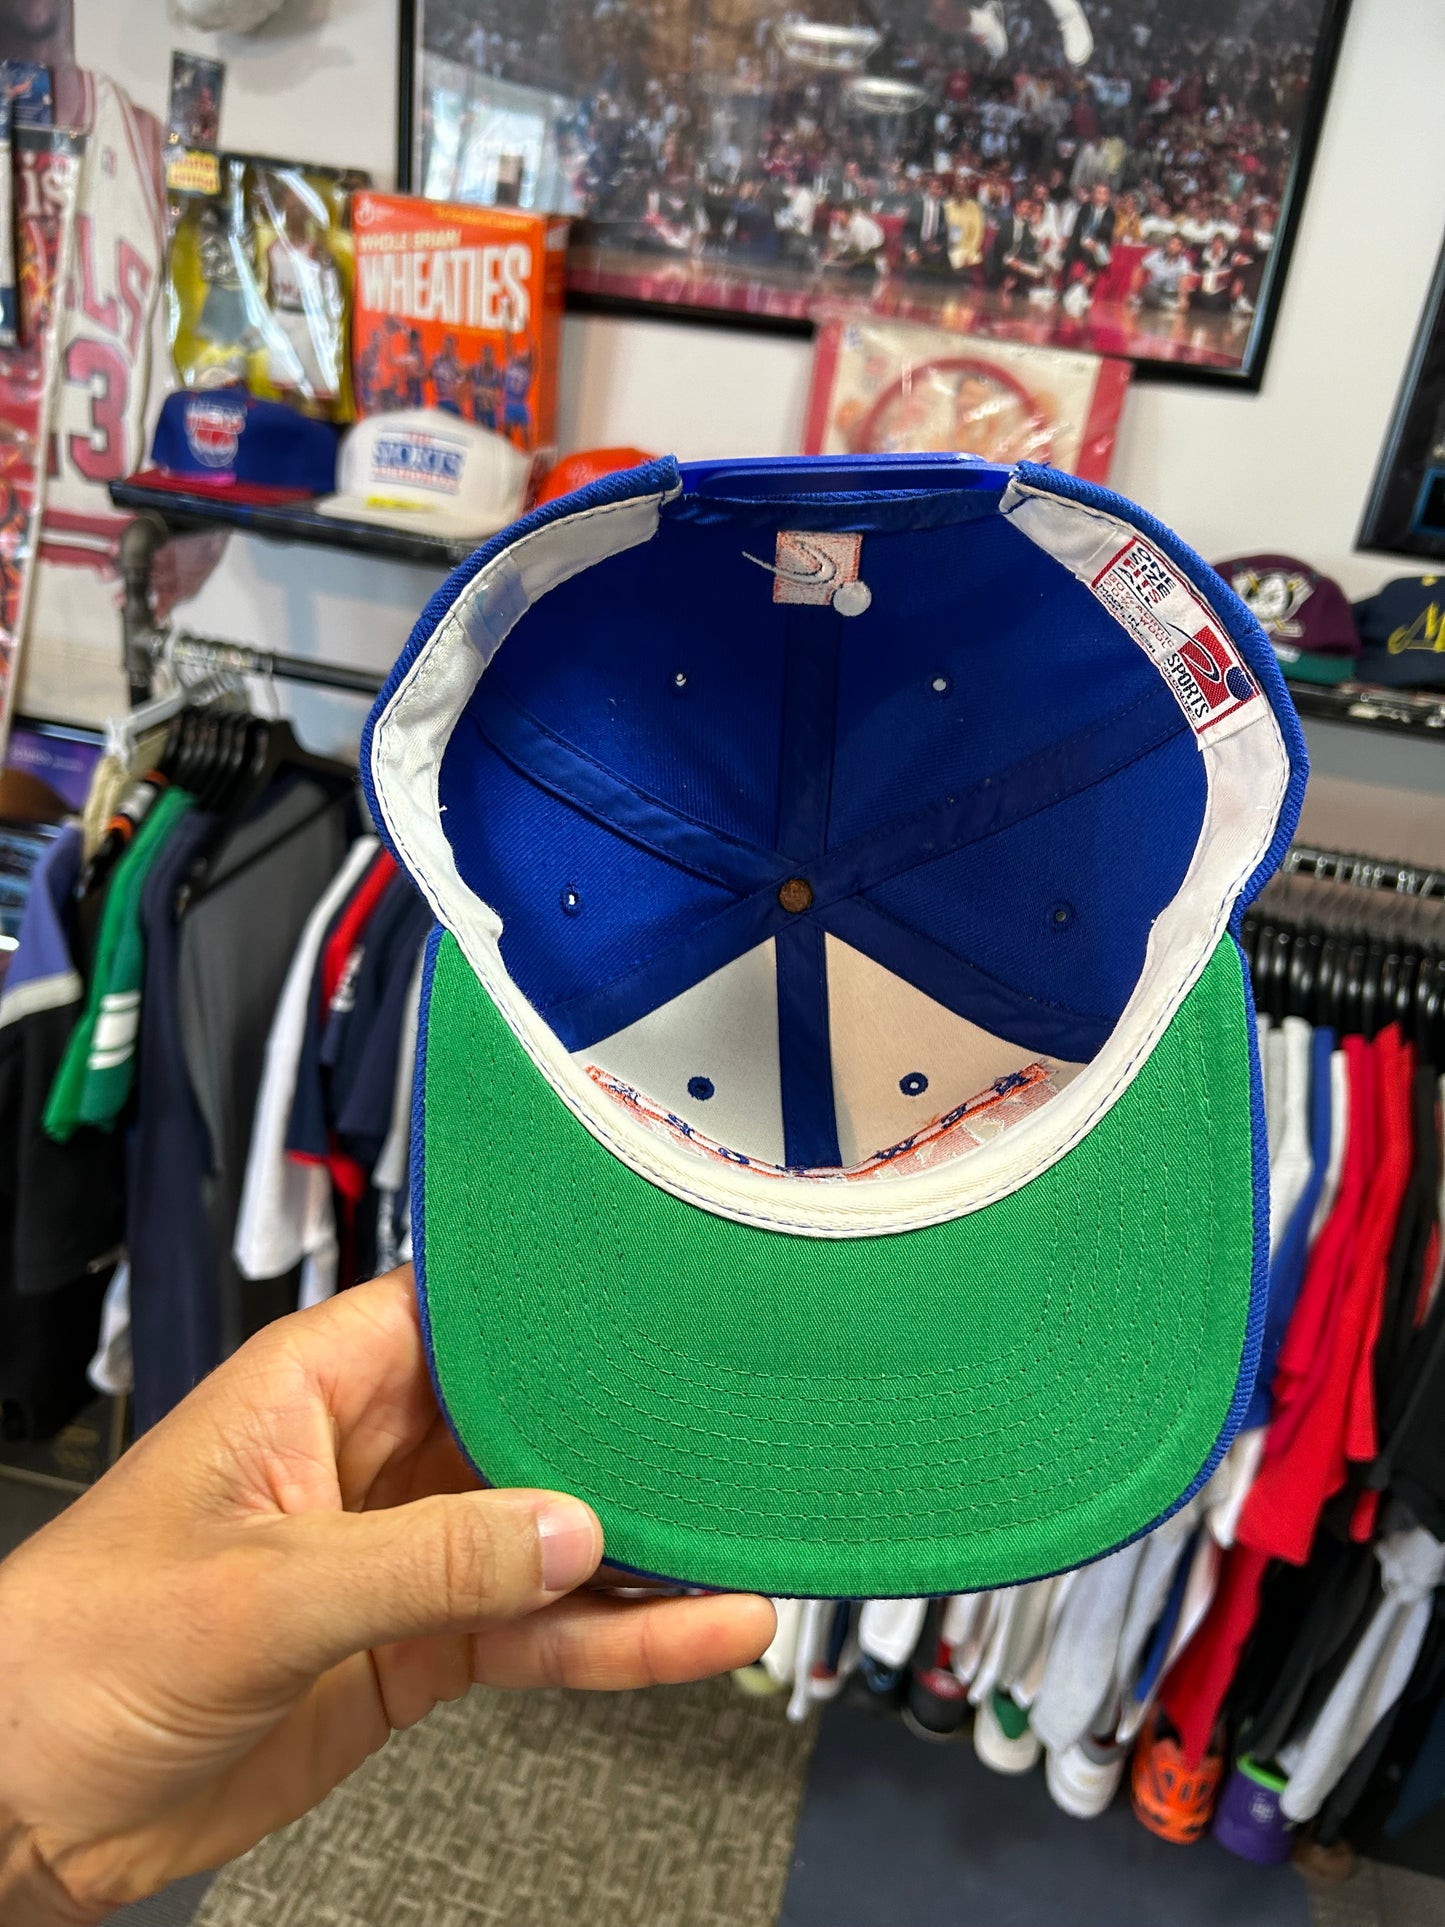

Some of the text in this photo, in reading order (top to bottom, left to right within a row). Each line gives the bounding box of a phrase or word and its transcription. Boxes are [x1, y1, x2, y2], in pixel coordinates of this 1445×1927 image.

[358, 244, 533, 333] WHEATIES
[1118, 567, 1153, 609] ALL
[1123, 558, 1162, 604] FITS
[1129, 552, 1171, 598] SIZE
[1137, 547, 1176, 590] ONE
[1096, 583, 1140, 627] MADE IN
[1103, 578, 1166, 649] 20% WOOL
[1135, 605, 1175, 648] ACRYLIC
[1167, 653, 1209, 718] SPORTS
